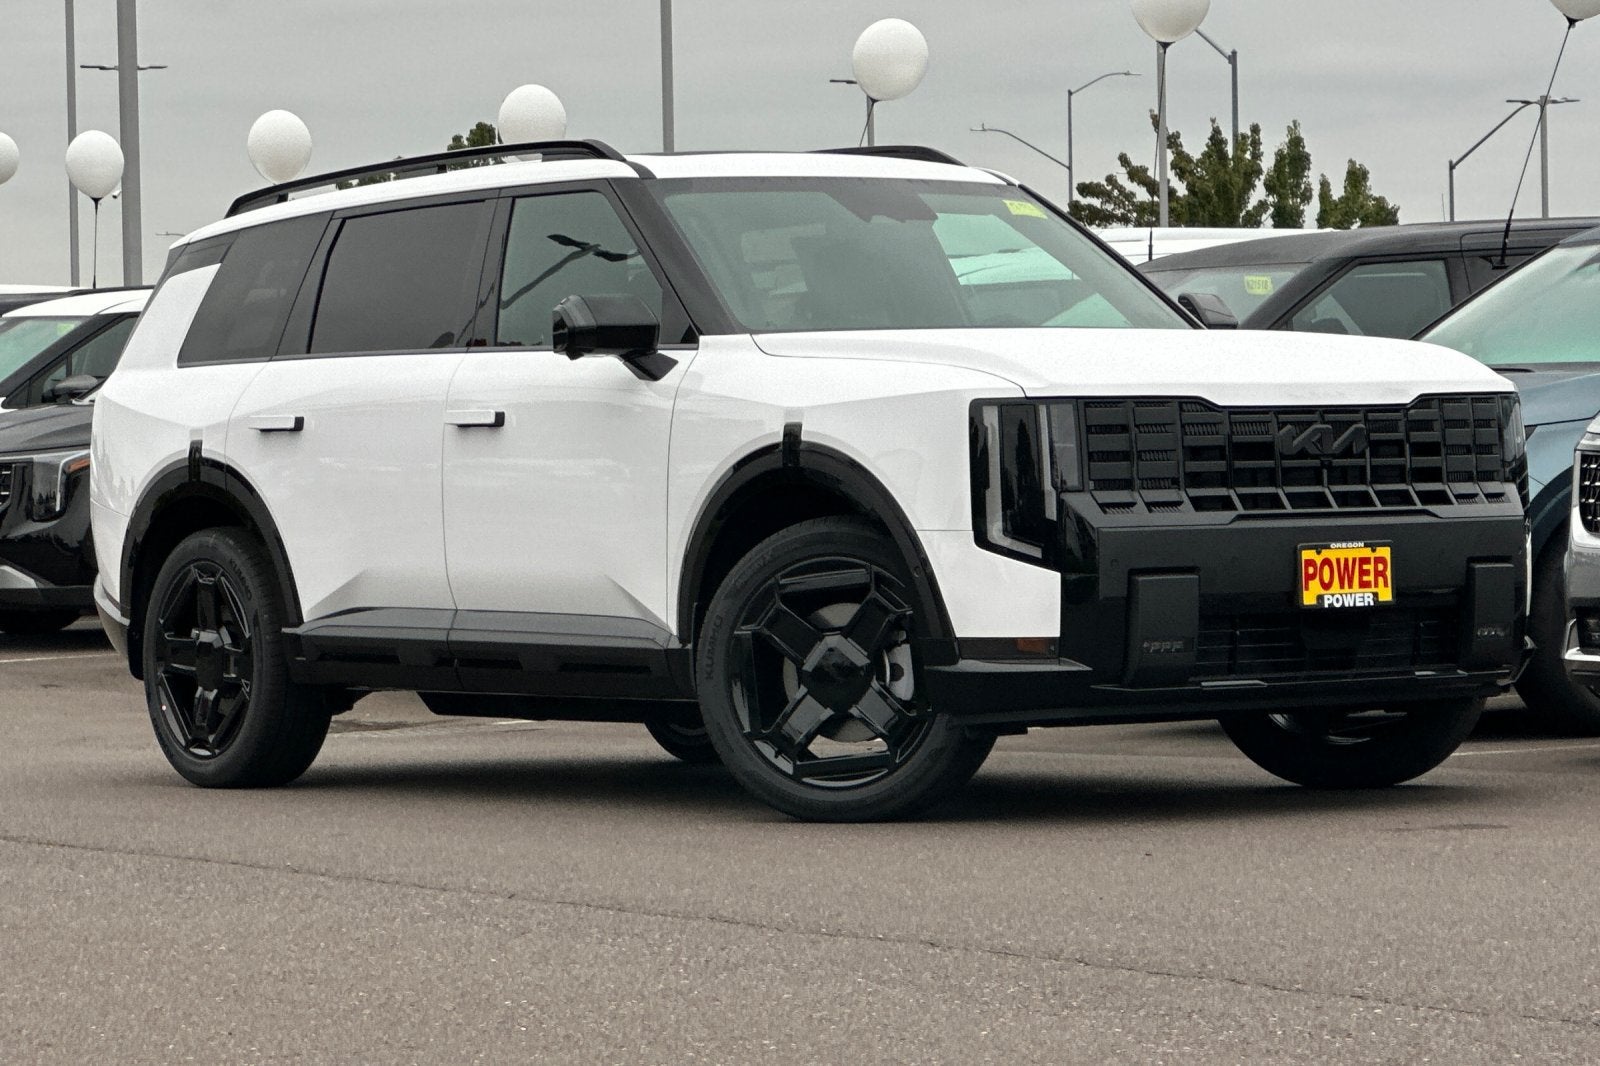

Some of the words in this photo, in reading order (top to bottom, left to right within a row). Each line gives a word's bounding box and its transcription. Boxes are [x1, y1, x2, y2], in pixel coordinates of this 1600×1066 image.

[1303, 556, 1389, 591] POWER
[1324, 593, 1374, 608] POWER
[704, 614, 722, 680] KUMHO
